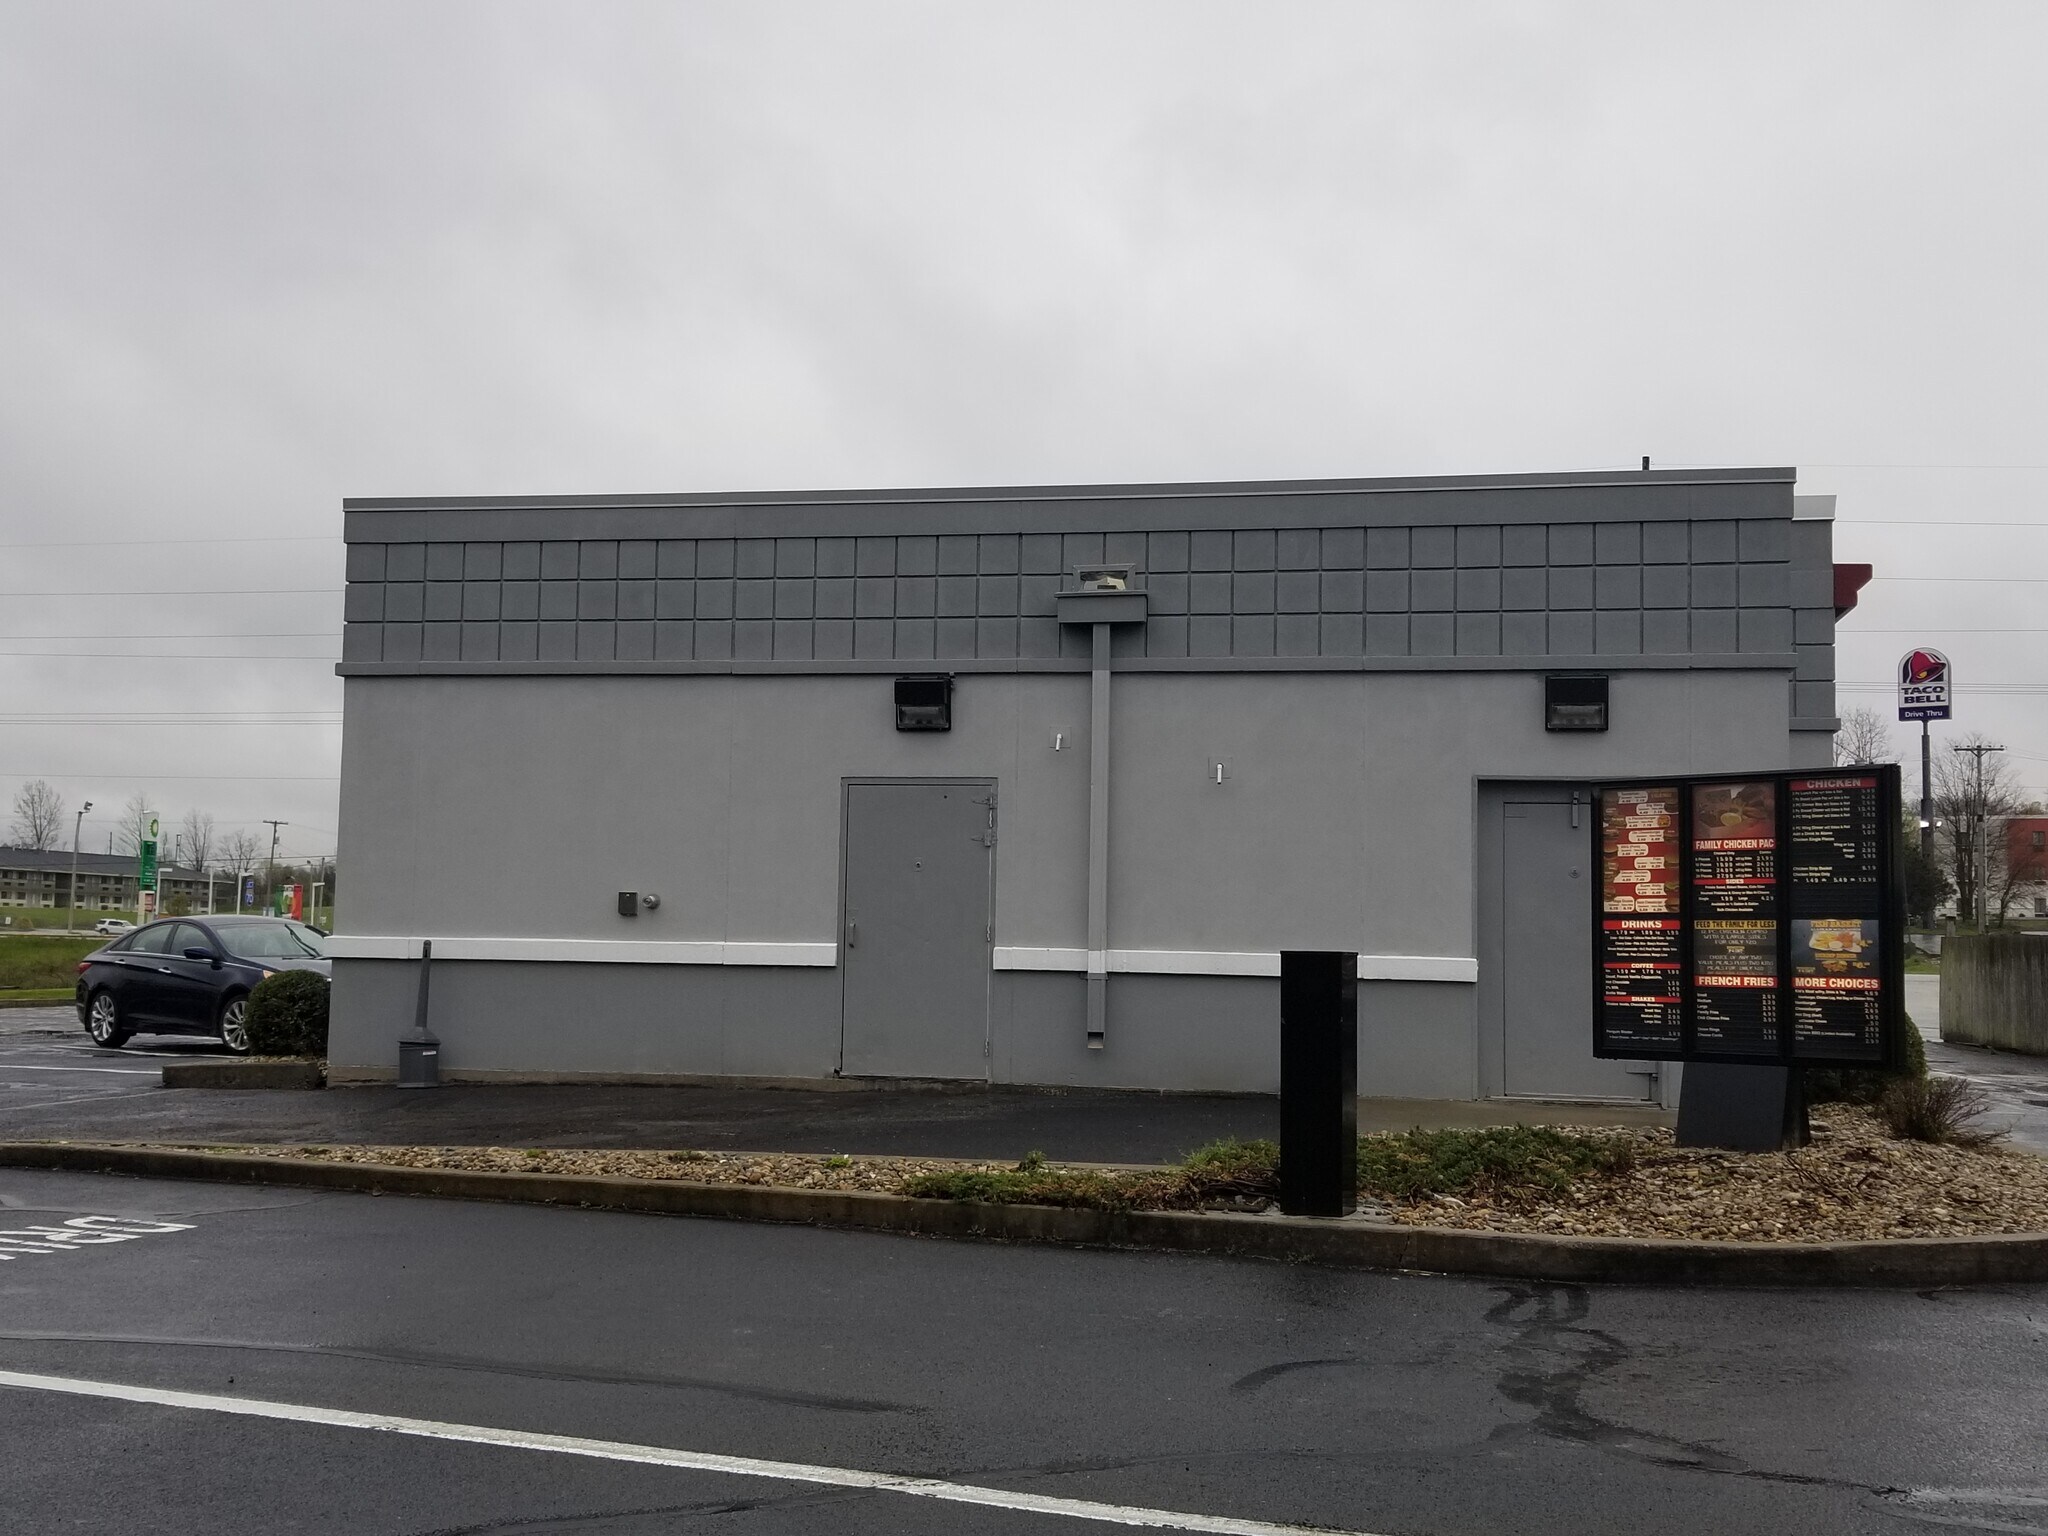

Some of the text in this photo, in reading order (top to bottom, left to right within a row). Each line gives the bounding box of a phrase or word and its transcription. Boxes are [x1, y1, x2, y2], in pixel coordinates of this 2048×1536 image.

[1901, 686, 1945, 695] TACO
[1904, 695, 1946, 704] BELL
[1807, 778, 1861, 788] CHICKEN
[1695, 839, 1774, 849] FAMILY CHICKEN PAC
[1621, 920, 1662, 928] DRINKS
[1698, 976, 1774, 986] FRENCH FRIES
[1795, 978, 1879, 988] MORE CHOICES
